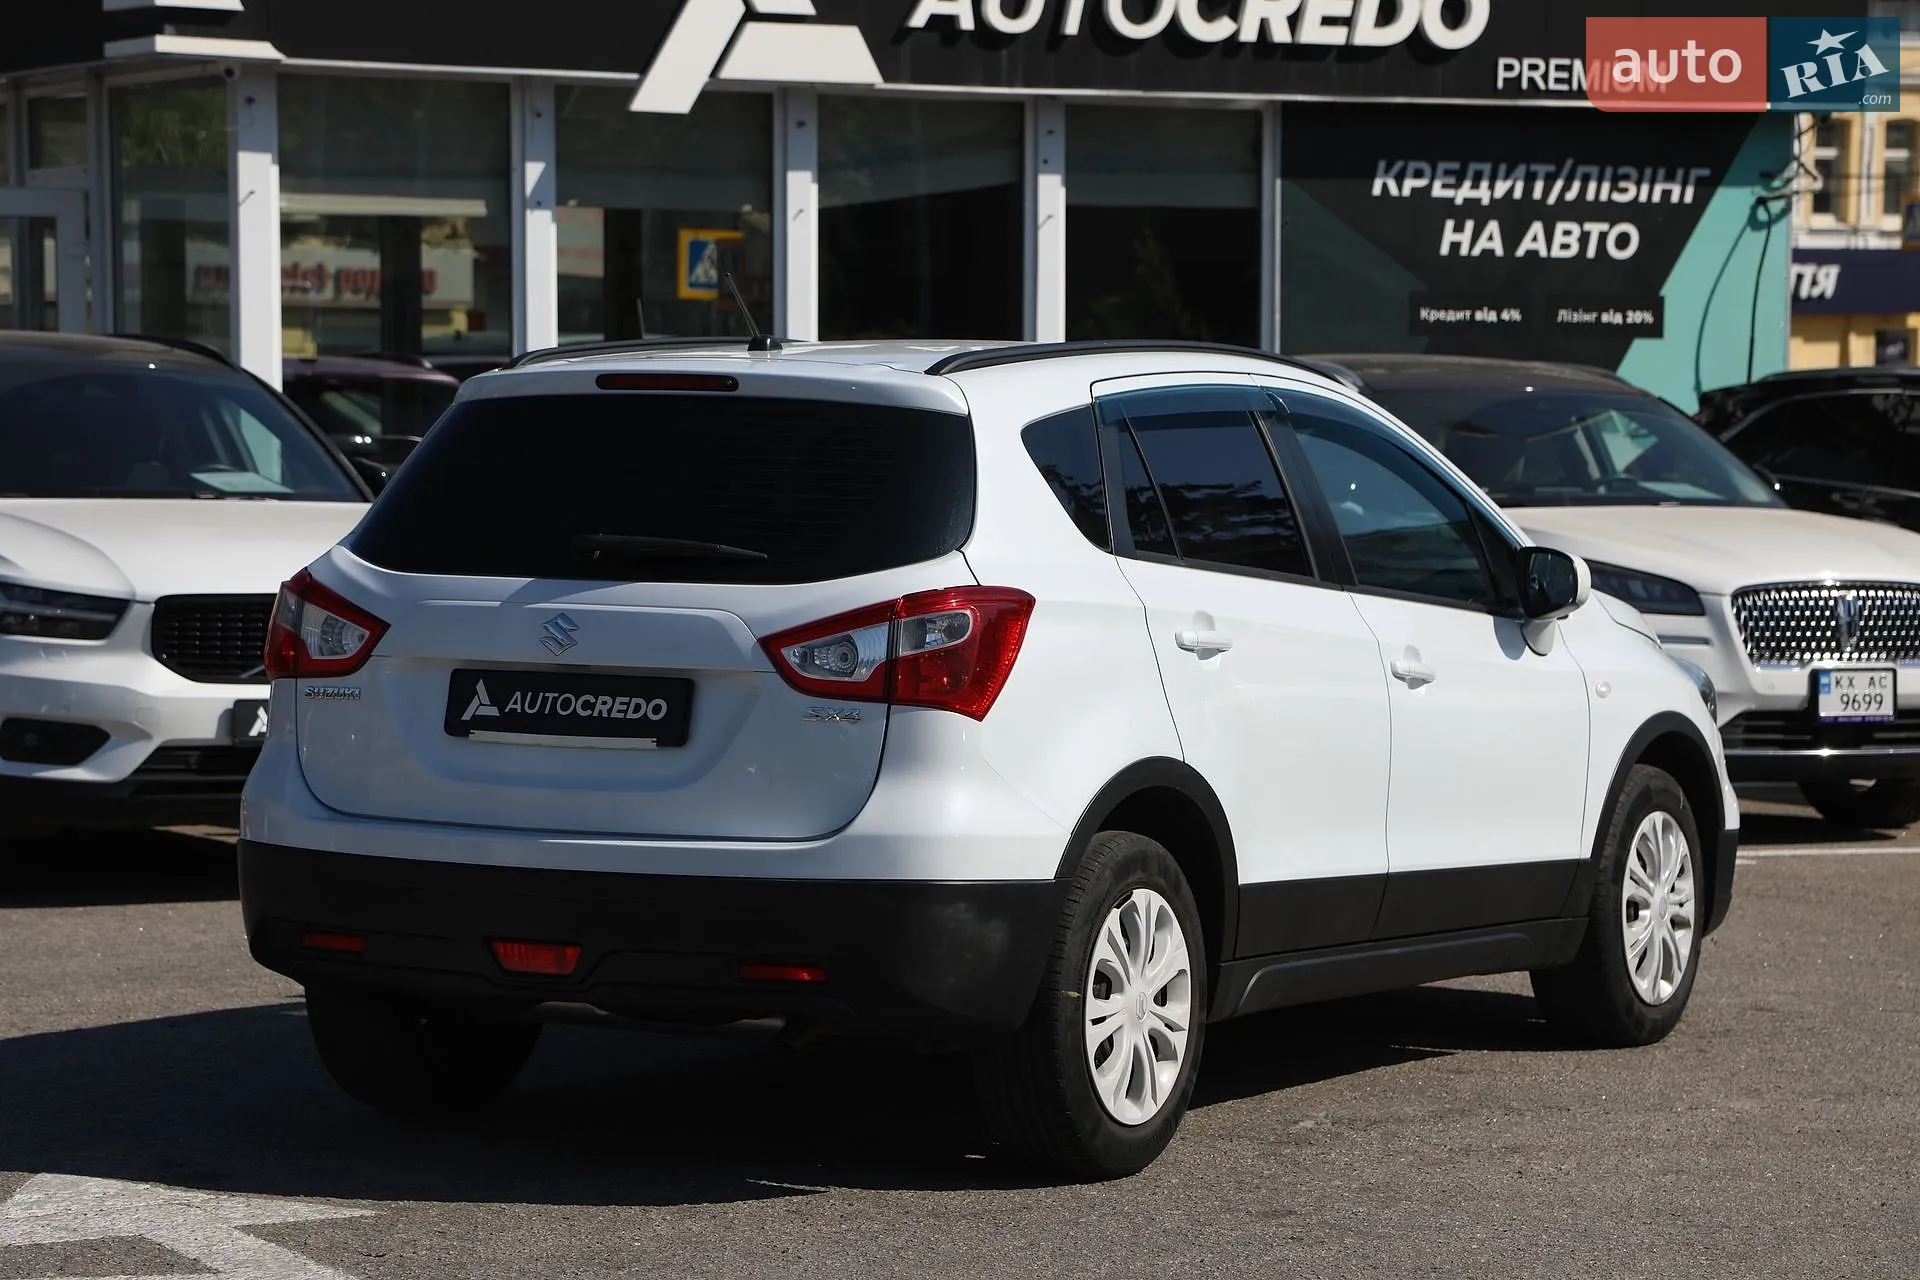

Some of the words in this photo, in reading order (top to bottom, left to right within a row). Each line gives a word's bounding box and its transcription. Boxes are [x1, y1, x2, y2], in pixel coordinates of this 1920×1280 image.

[1371, 158, 1711, 205] КРЕДИТ/ЛІЗІНГ
[1439, 219, 1504, 257] НА
[1515, 220, 1640, 260] АВТО
[1420, 308, 1472, 323] Кредит
[1474, 307, 1497, 322] від
[1500, 308, 1522, 322] 4%
[1601, 308, 1623, 325] від
[1626, 310, 1654, 325] 20%
[304, 686, 361, 700] SUZUKI
[504, 691, 668, 721] AUTOCREDO
[1839, 693, 1884, 712] 9699
[801, 706, 862, 721] SX4
